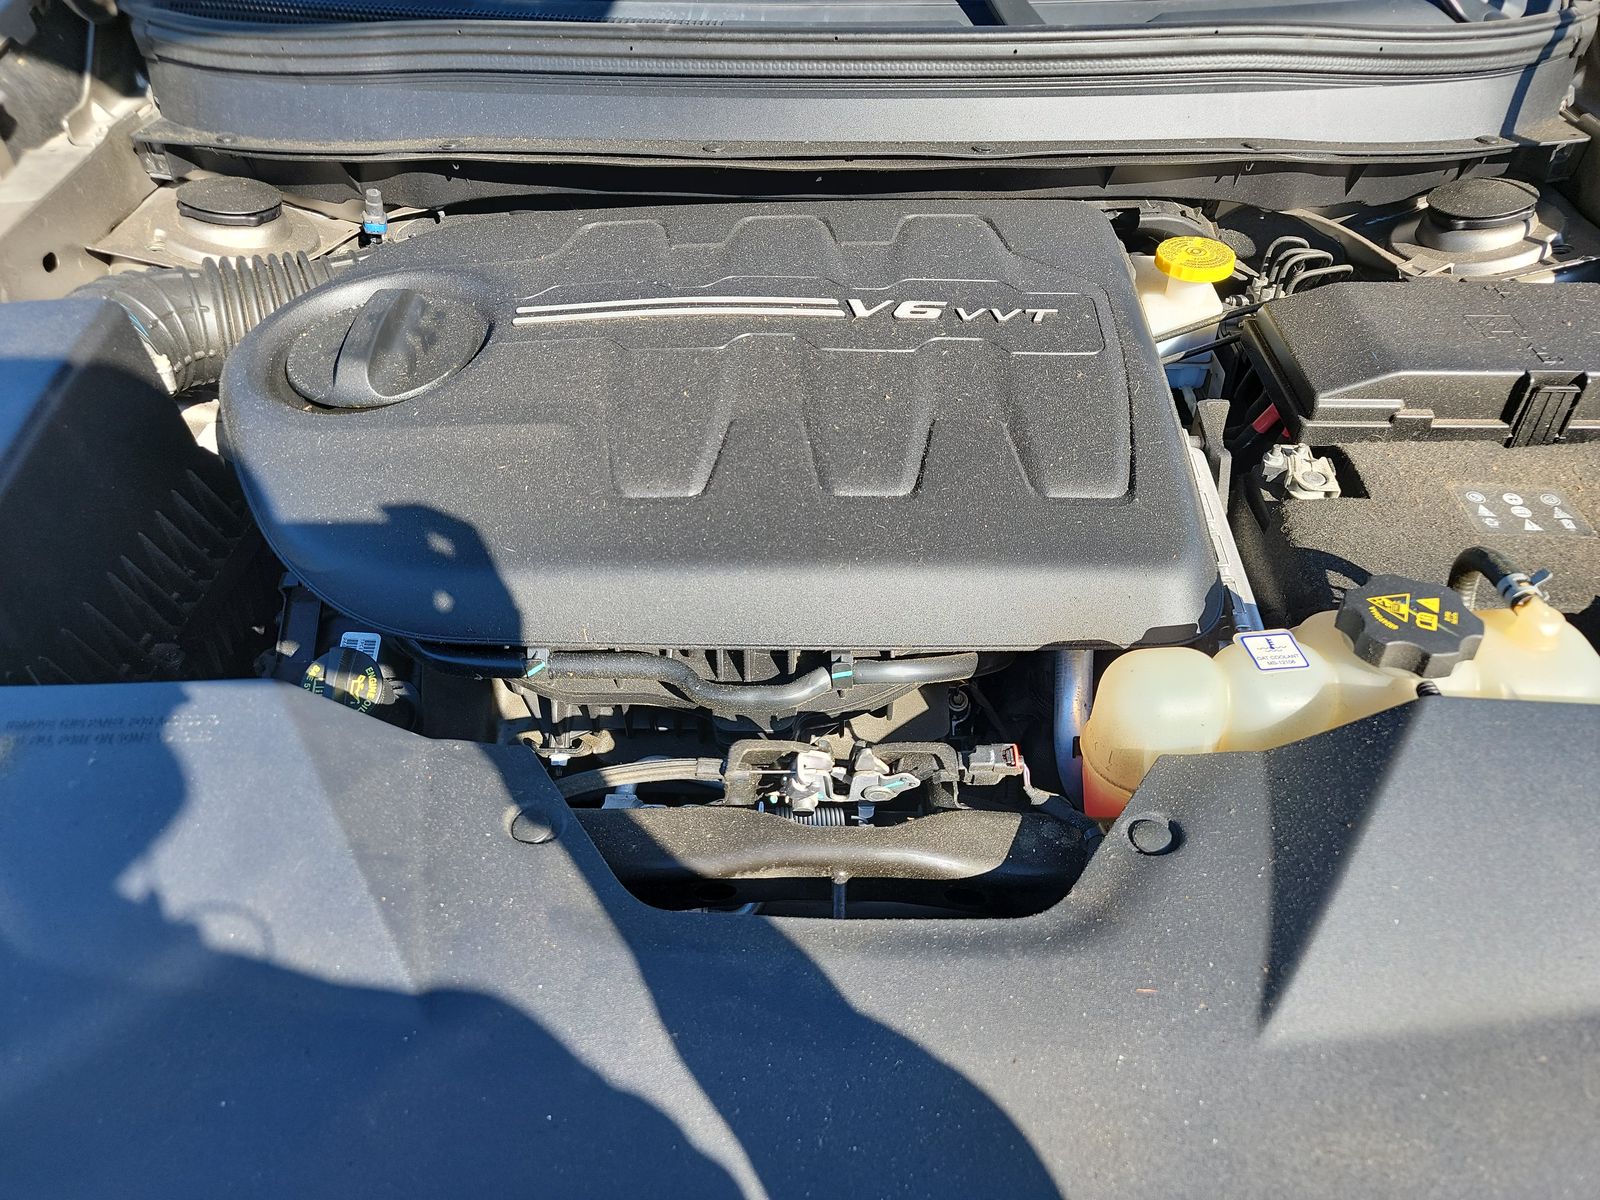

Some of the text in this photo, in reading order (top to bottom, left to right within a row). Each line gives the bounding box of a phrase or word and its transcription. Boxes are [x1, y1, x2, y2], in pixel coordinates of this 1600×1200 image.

[846, 299, 1059, 323] V6 VVT
[365, 666, 378, 700] ENGINE
